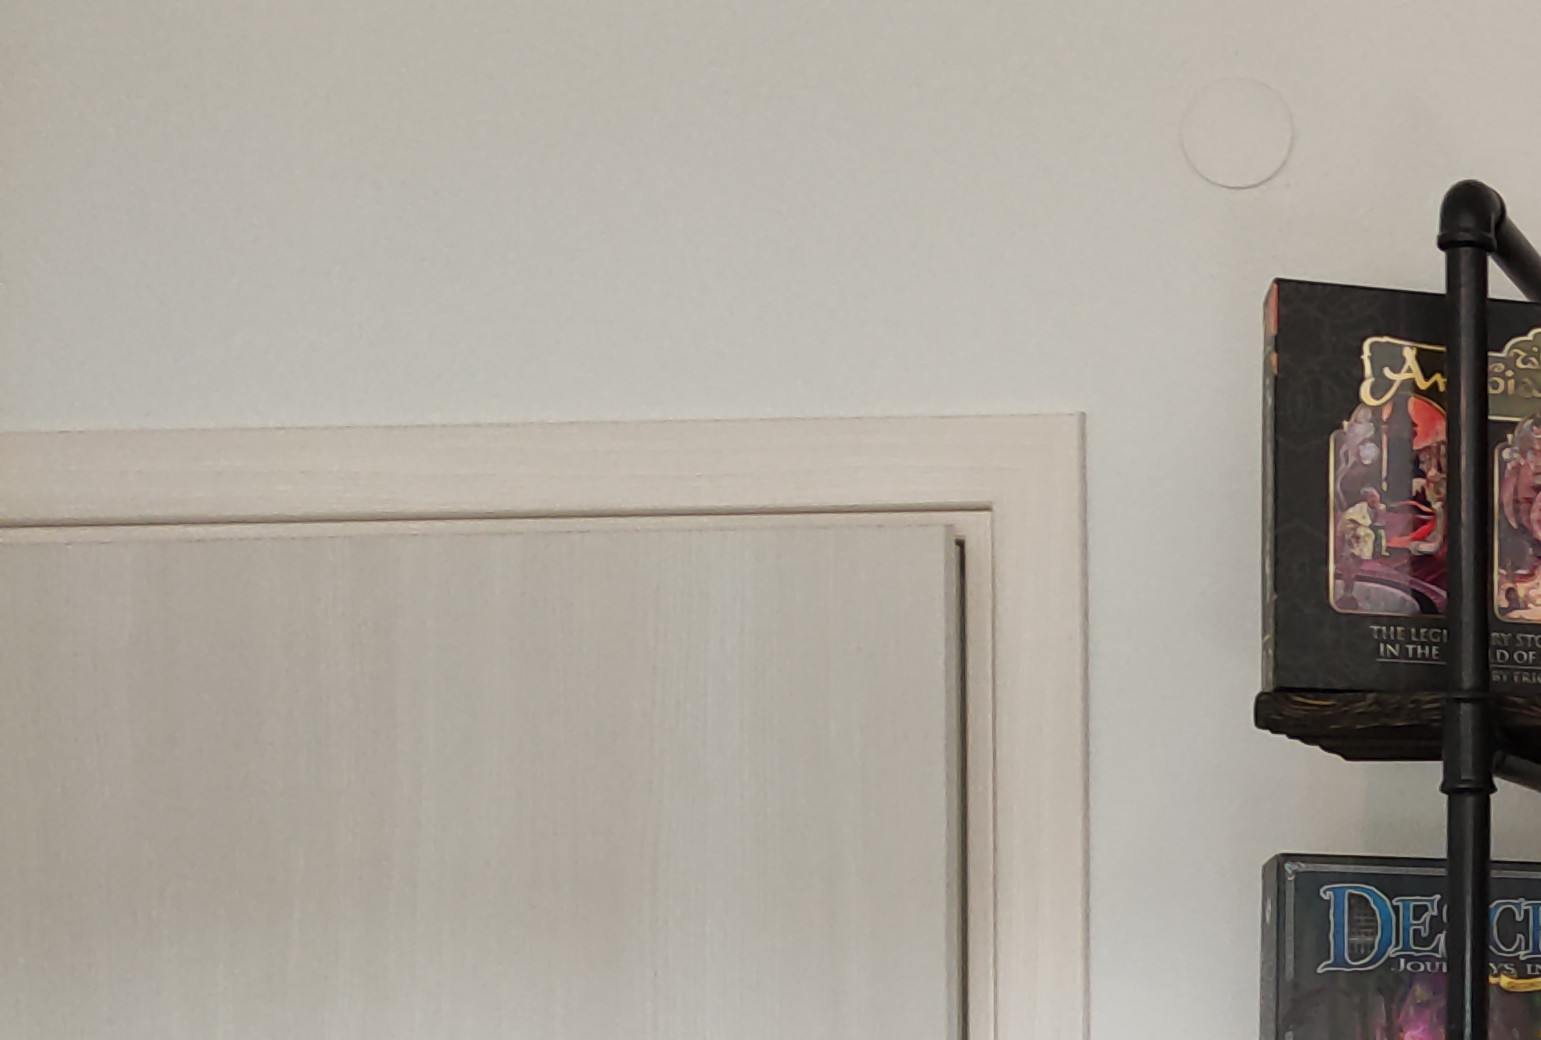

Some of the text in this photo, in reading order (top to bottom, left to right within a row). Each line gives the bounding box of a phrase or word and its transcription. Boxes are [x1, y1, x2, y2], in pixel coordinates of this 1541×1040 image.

[1369, 625, 1405, 641] THE
[1410, 627, 1512, 647] LEGRY
[1379, 642, 1400, 658] IN
[1404, 644, 1440, 660] THE
[1512, 650, 1537, 664] OF
